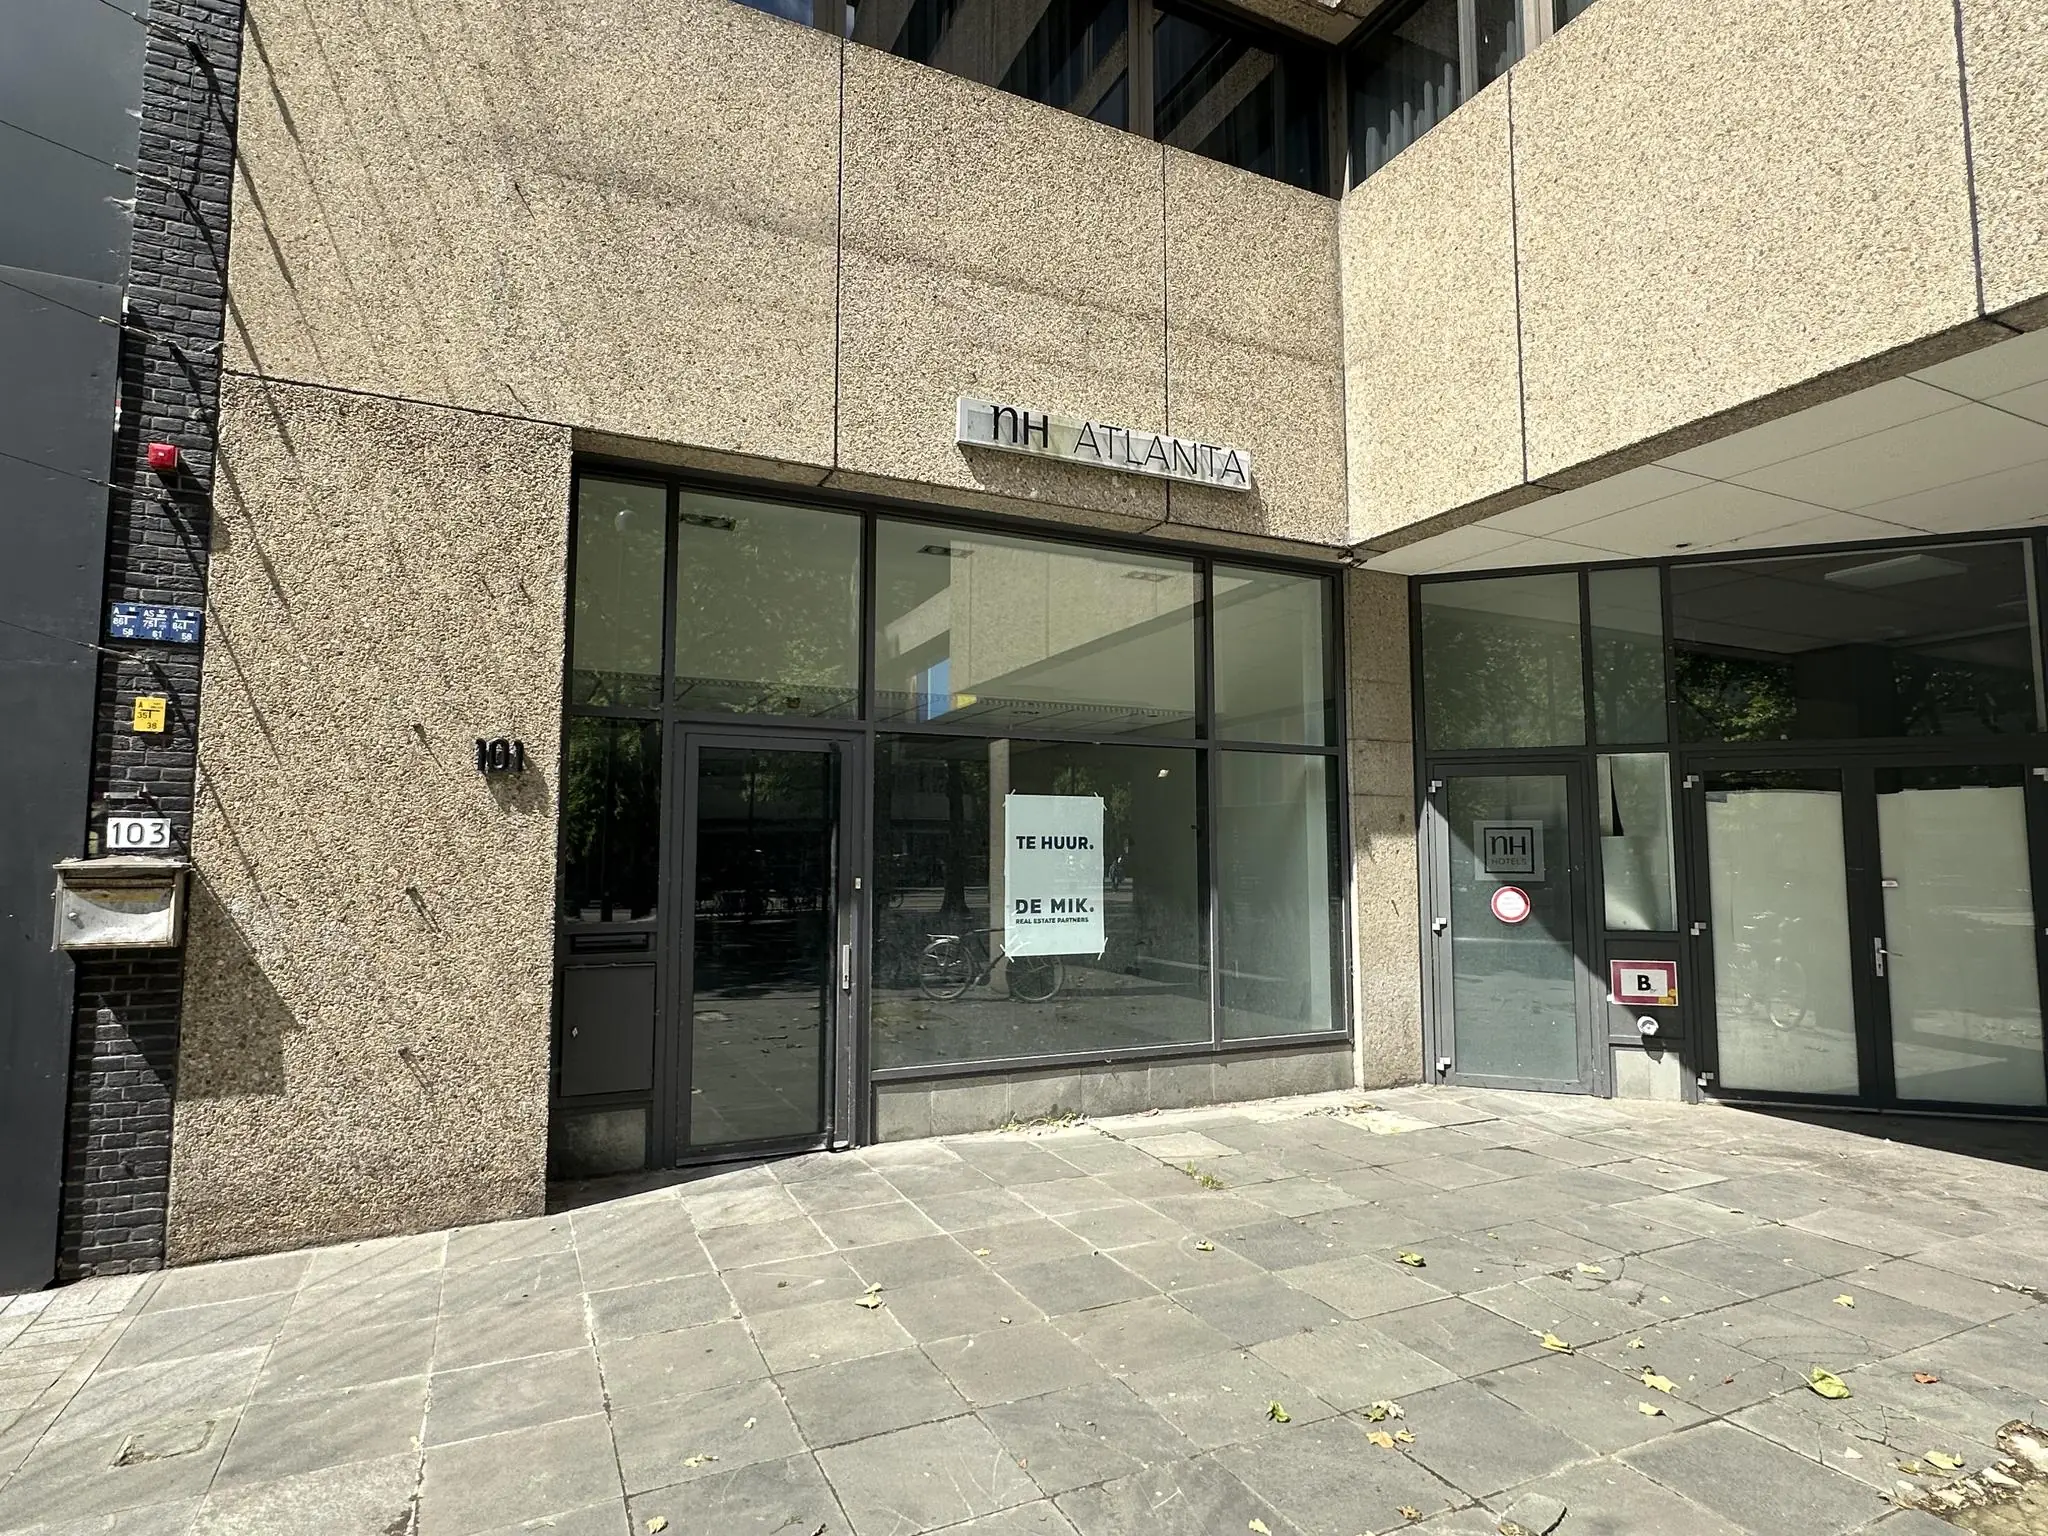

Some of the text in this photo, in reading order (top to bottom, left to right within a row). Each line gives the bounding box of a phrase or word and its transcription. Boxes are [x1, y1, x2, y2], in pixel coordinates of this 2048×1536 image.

[1073, 421, 1247, 483] ATLANTA
[475, 738, 524, 771] 101
[112, 822, 166, 846] 103
[1015, 836, 1094, 850] TE HUUR.
[1015, 897, 1094, 914] DE MIK.
[1637, 974, 1651, 991] B
